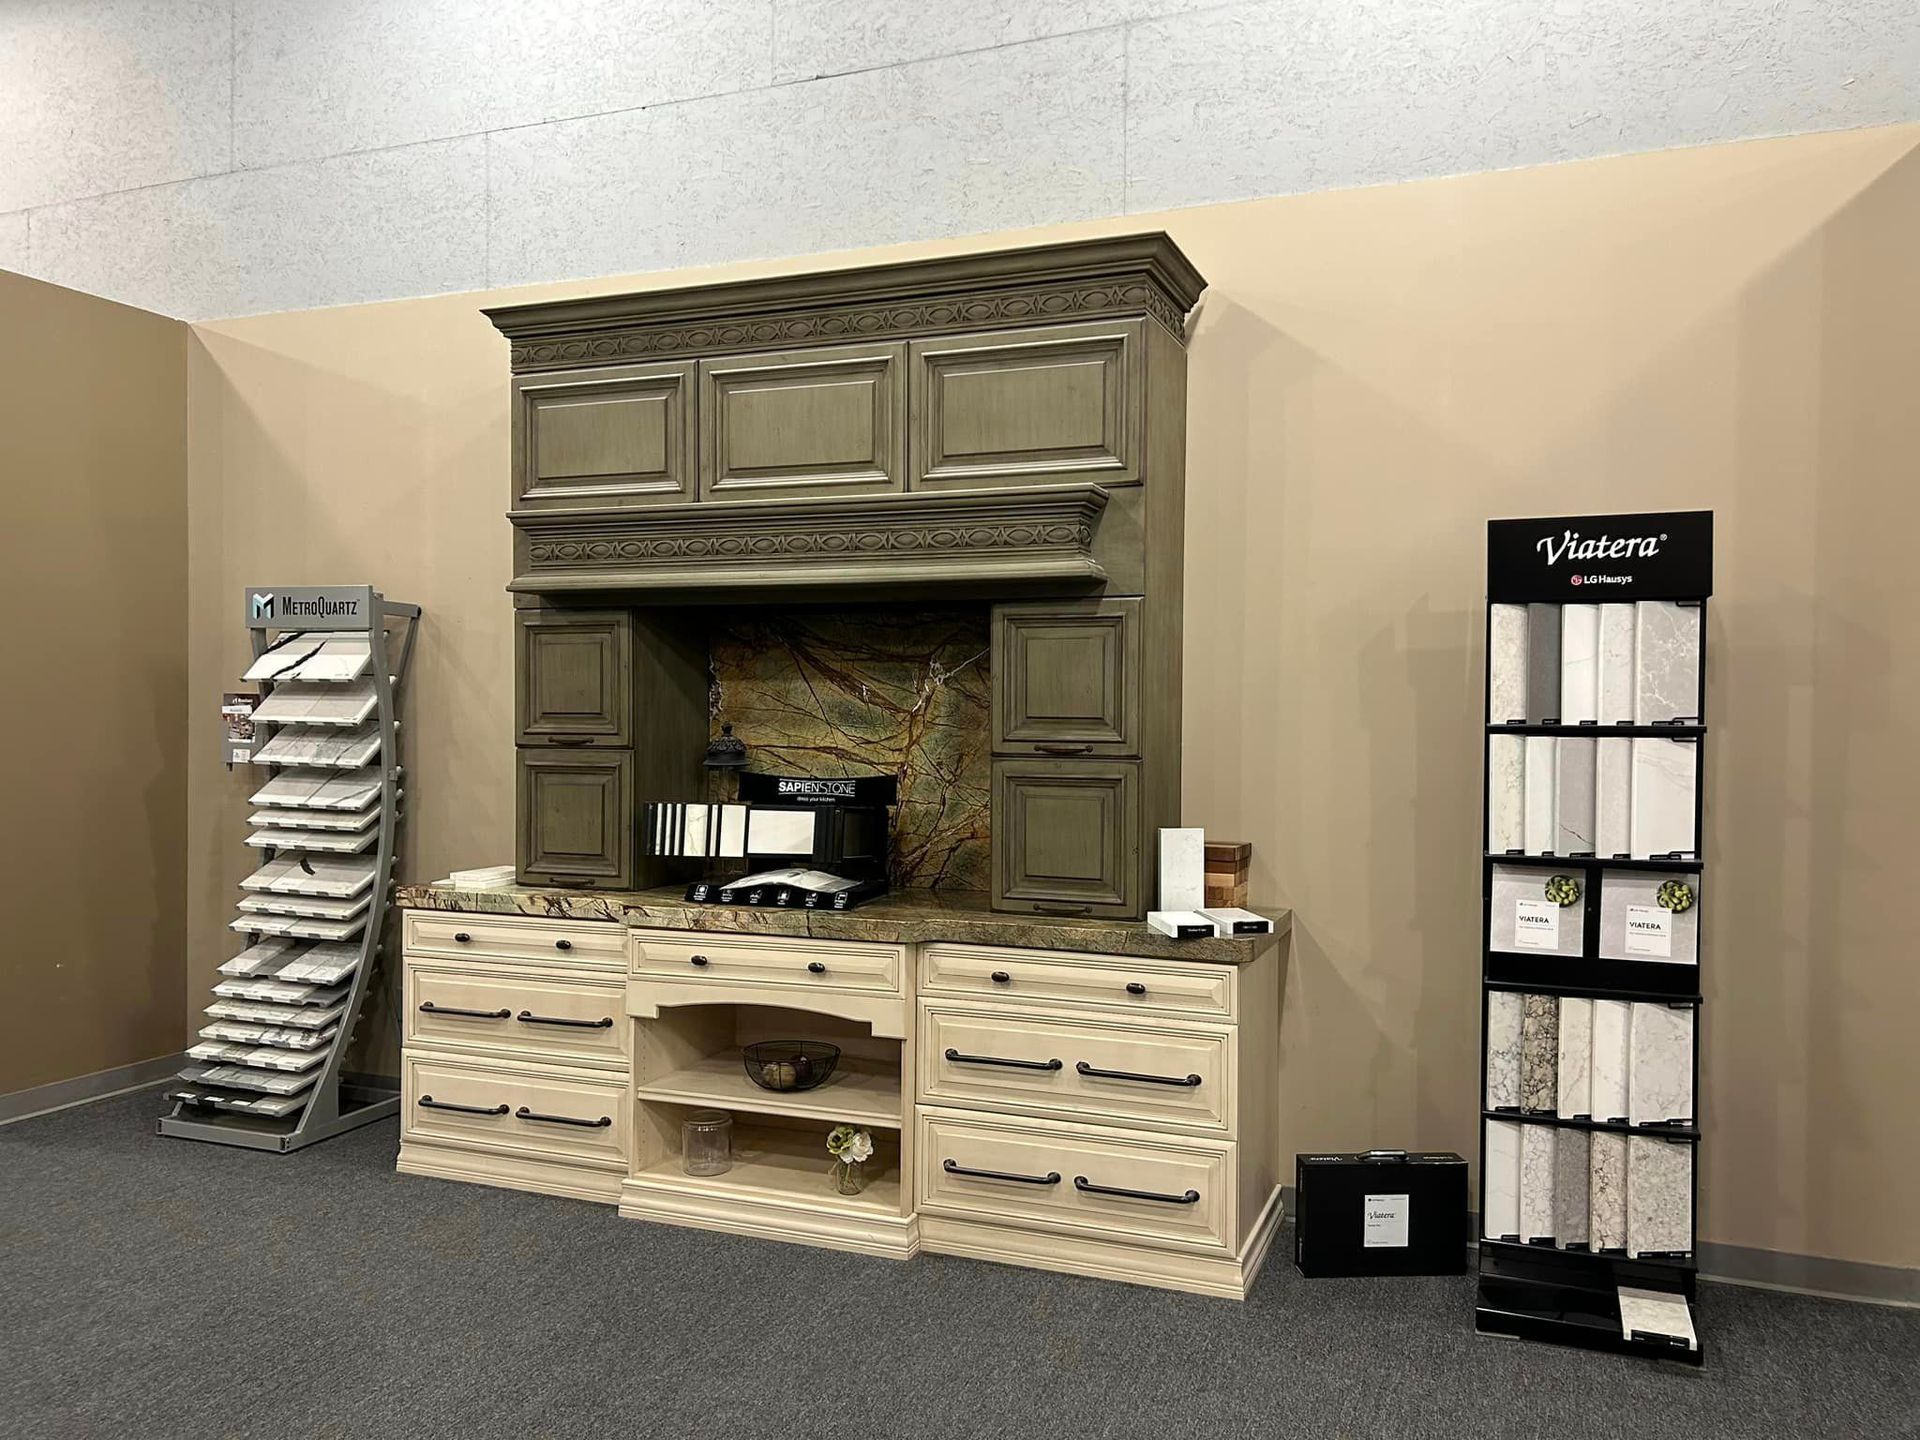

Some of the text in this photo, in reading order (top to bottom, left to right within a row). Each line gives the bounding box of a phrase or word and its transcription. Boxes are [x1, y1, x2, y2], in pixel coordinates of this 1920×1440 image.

[1583, 574, 1633, 586] LG Hausys
[778, 781, 856, 795] SAPIENSTONE
[1518, 915, 1550, 924] VIATERA
[1629, 921, 1662, 930] VIATERA
